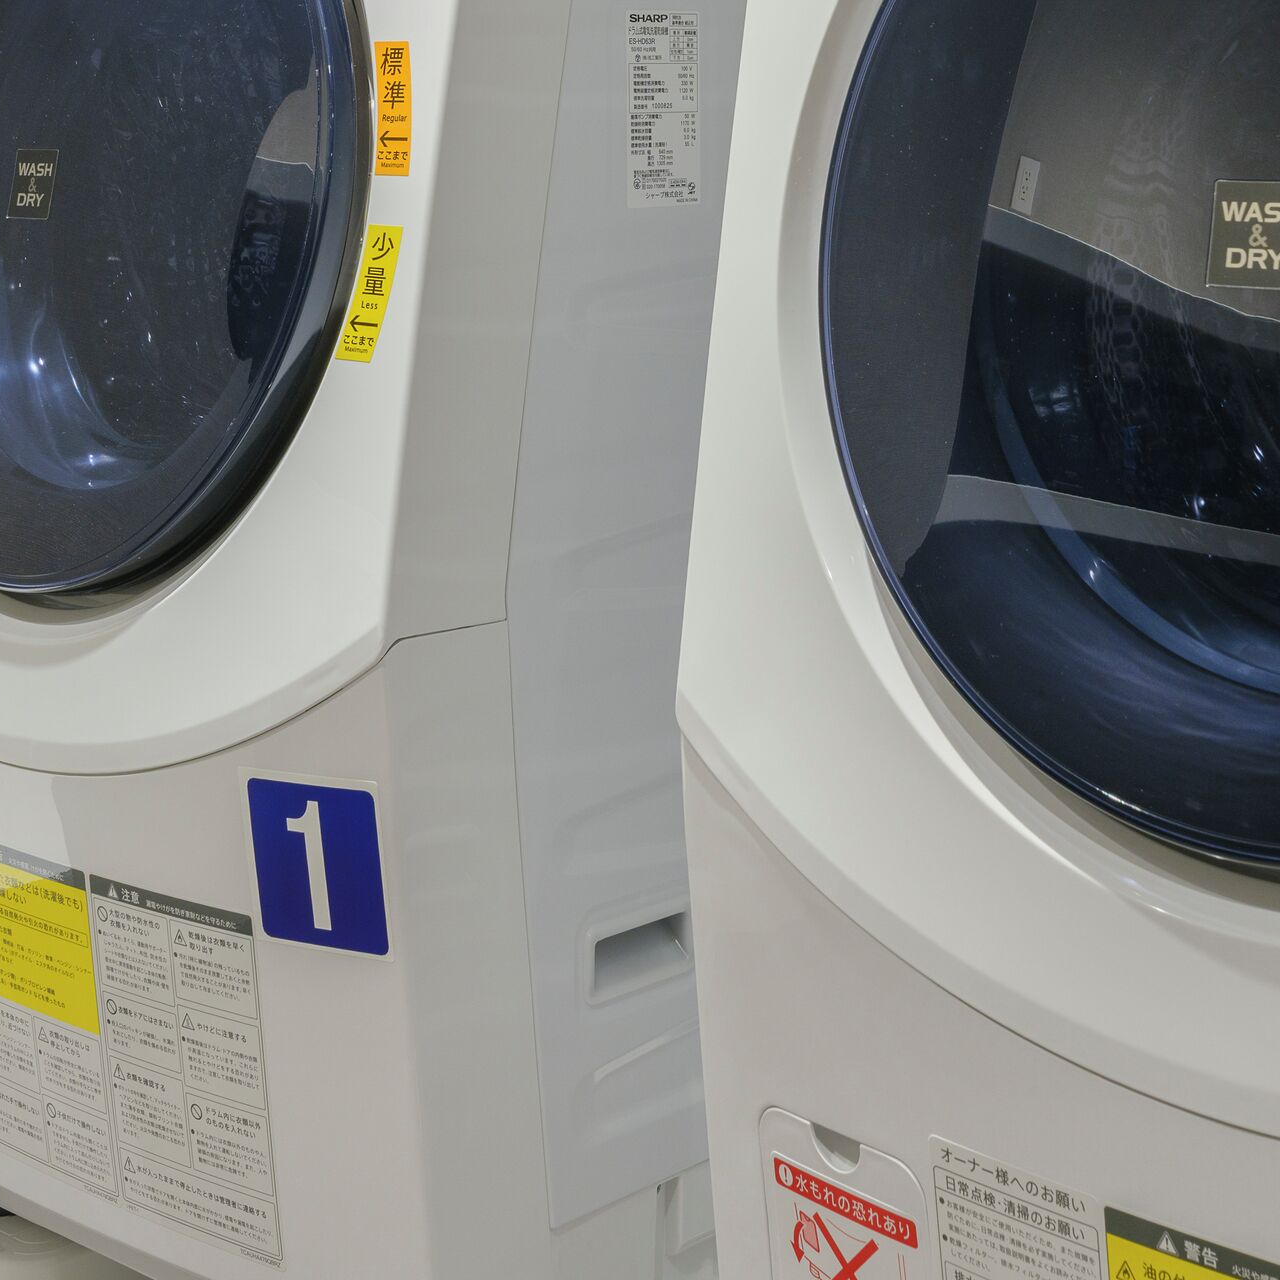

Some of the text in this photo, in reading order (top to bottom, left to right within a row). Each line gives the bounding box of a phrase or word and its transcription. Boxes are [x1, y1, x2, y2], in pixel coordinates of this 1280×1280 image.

[629, 13, 668, 23] SHARP
[381, 47, 407, 110] 標準
[381, 114, 408, 125] Regular
[376, 150, 408, 161] ここまで
[18, 162, 54, 177] WASH
[28, 177, 37, 193] &
[16, 192, 45, 207] DRY
[1248, 223, 1269, 248] &
[362, 232, 395, 297] 少量
[361, 300, 379, 311] Less
[343, 333, 375, 347] ここまで
[285, 799, 333, 932] 1
[120, 886, 141, 906] 注意
[196, 1023, 248, 1044] やけどに注意する
[940, 1146, 1086, 1213] オーナー様へのお願い
[795, 1173, 911, 1241] 水もれの恐れあり
[945, 1174, 1086, 1241] 日常点検・清掃のお願い
[1183, 1239, 1219, 1269] 警告
